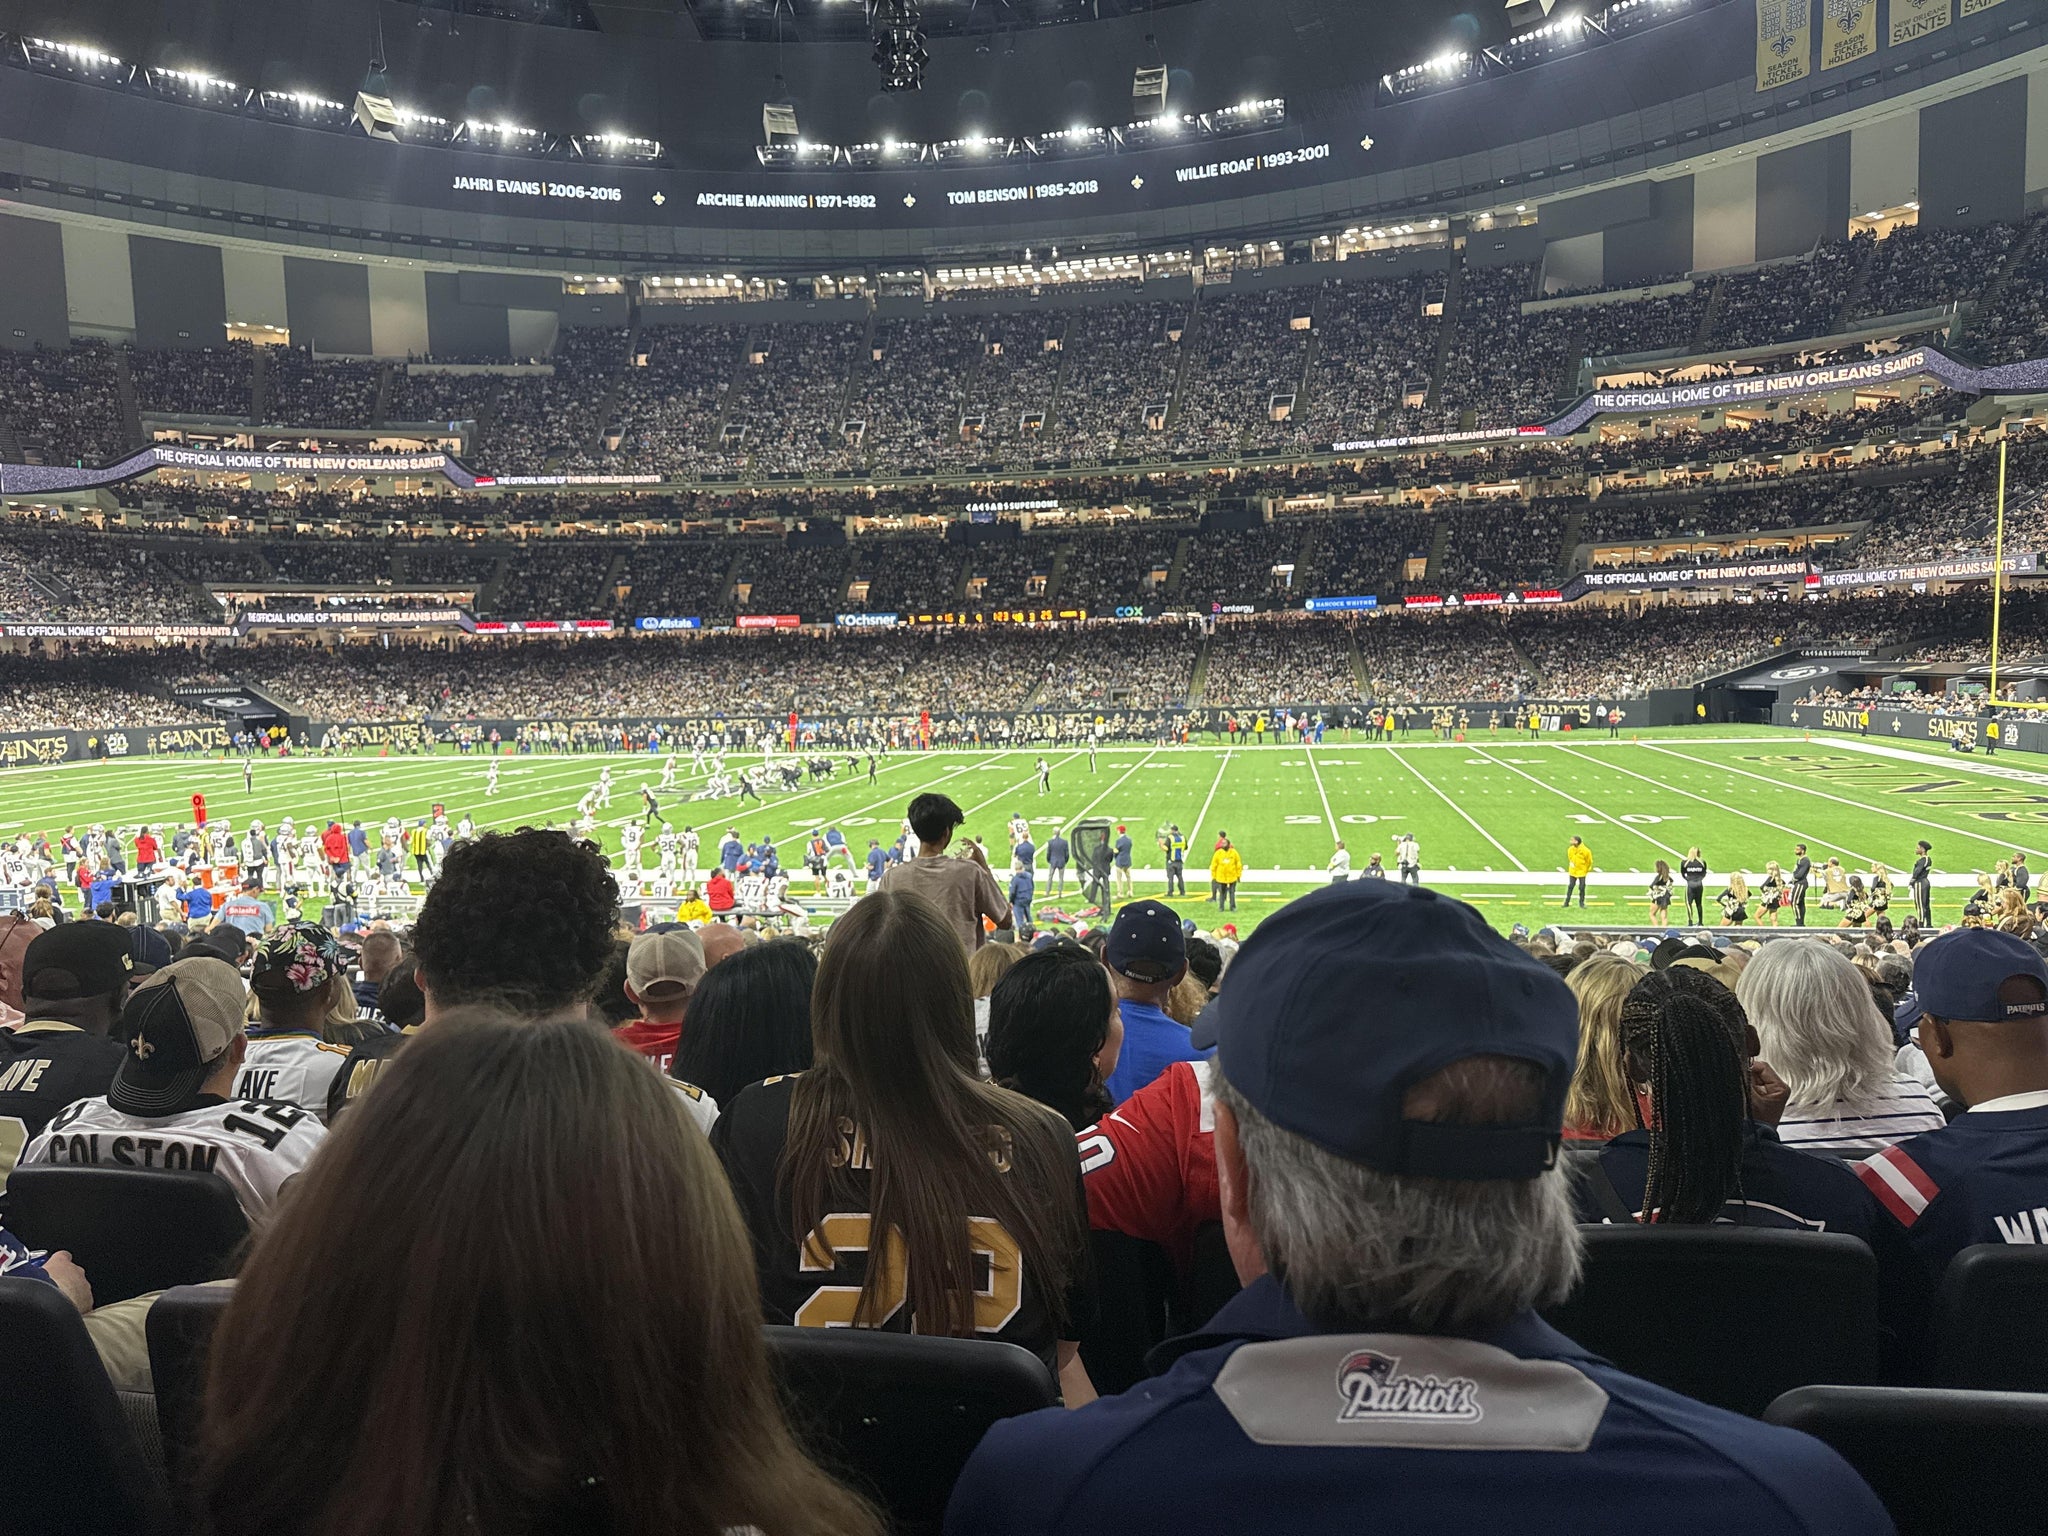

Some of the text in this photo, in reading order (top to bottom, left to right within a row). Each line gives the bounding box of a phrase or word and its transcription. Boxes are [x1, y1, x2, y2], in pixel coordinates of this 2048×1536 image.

[1893, 12, 1946, 42] SAINTS
[1833, 40, 1865, 56] TICKET
[1834, 33, 1865, 49] SEASON
[1828, 45, 1868, 65] HOLDERS
[1767, 57, 1799, 72] SEASON
[1767, 64, 1799, 78] TICKET
[1762, 68, 1803, 87] HOLDERS
[1176, 144, 1330, 183] WILLIE ROAF 1993-2001
[453, 177, 621, 201] JAHRI EVANS 2006-2016
[947, 180, 1098, 205] TOM BENSON 1985-2018
[697, 193, 876, 208] ARCHIE MANNING 1971-1982
[1593, 352, 1924, 406] THE OFFICIAL HOME OF THE NEW ORLEANS SAINTS
[1863, 425, 1895, 437] SAINTS
[1347, 440, 1376, 450] OFFICIAL
[1377, 439, 1398, 448] HOME
[1398, 438, 1408, 446] OF
[1409, 437, 1424, 445] THE
[1426, 434, 1445, 444] NEW
[1446, 431, 1484, 442] ORLEANS
[1485, 428, 1516, 438] SAINTS
[1787, 438, 1821, 448] SAINTS
[153, 448, 445, 470] THE OFFICIAL HOME OF THE NEW ORLEANS SAINTS
[1708, 448, 1742, 458] SAINTS
[1550, 464, 1584, 474] SAINTS
[1630, 457, 1665, 467] SAINTS
[567, 476, 580, 484] THE
[632, 475, 660, 483] SAINTS
[196, 506, 228, 515] SAINTS
[1584, 563, 1796, 585] THE OFFICIAL HOME OF THE NEW ORLEANS
[1822, 573, 1835, 586] THE
[1836, 572, 1865, 585] OFFICIAL
[1866, 571, 1888, 583] HOME
[1889, 570, 1898, 581] OF
[1899, 568, 1915, 580] THE
[1917, 566, 1936, 578] NEW
[1938, 562, 1980, 576] ORLEANS
[1222, 604, 1254, 614] entergy
[1346, 599, 1377, 607] WHITNEY
[248, 610, 460, 623] THE OFFICIAL HOME OF THE NEW ORLEANS SAINTS
[1115, 606, 1143, 617] COX
[845, 613, 897, 626] Ochsner
[8, 626, 231, 637] THE OFFICIAL HOME OF THE NEW ORLEANS SAINTS
[1823, 709, 1863, 729] SAINTS
[160, 727, 225, 750] SAINTS
[661, 841, 674, 852] 26
[744, 884, 761, 896] 77
[833, 887, 846, 898] 71
[2007, 1003, 2046, 1016] PATRIOTS
[0, 1059, 52, 1092] AVE
[237, 1070, 279, 1100] AVE
[49, 1134, 219, 1173] COLSTON
[1336, 1371, 1484, 1424] Patriots
